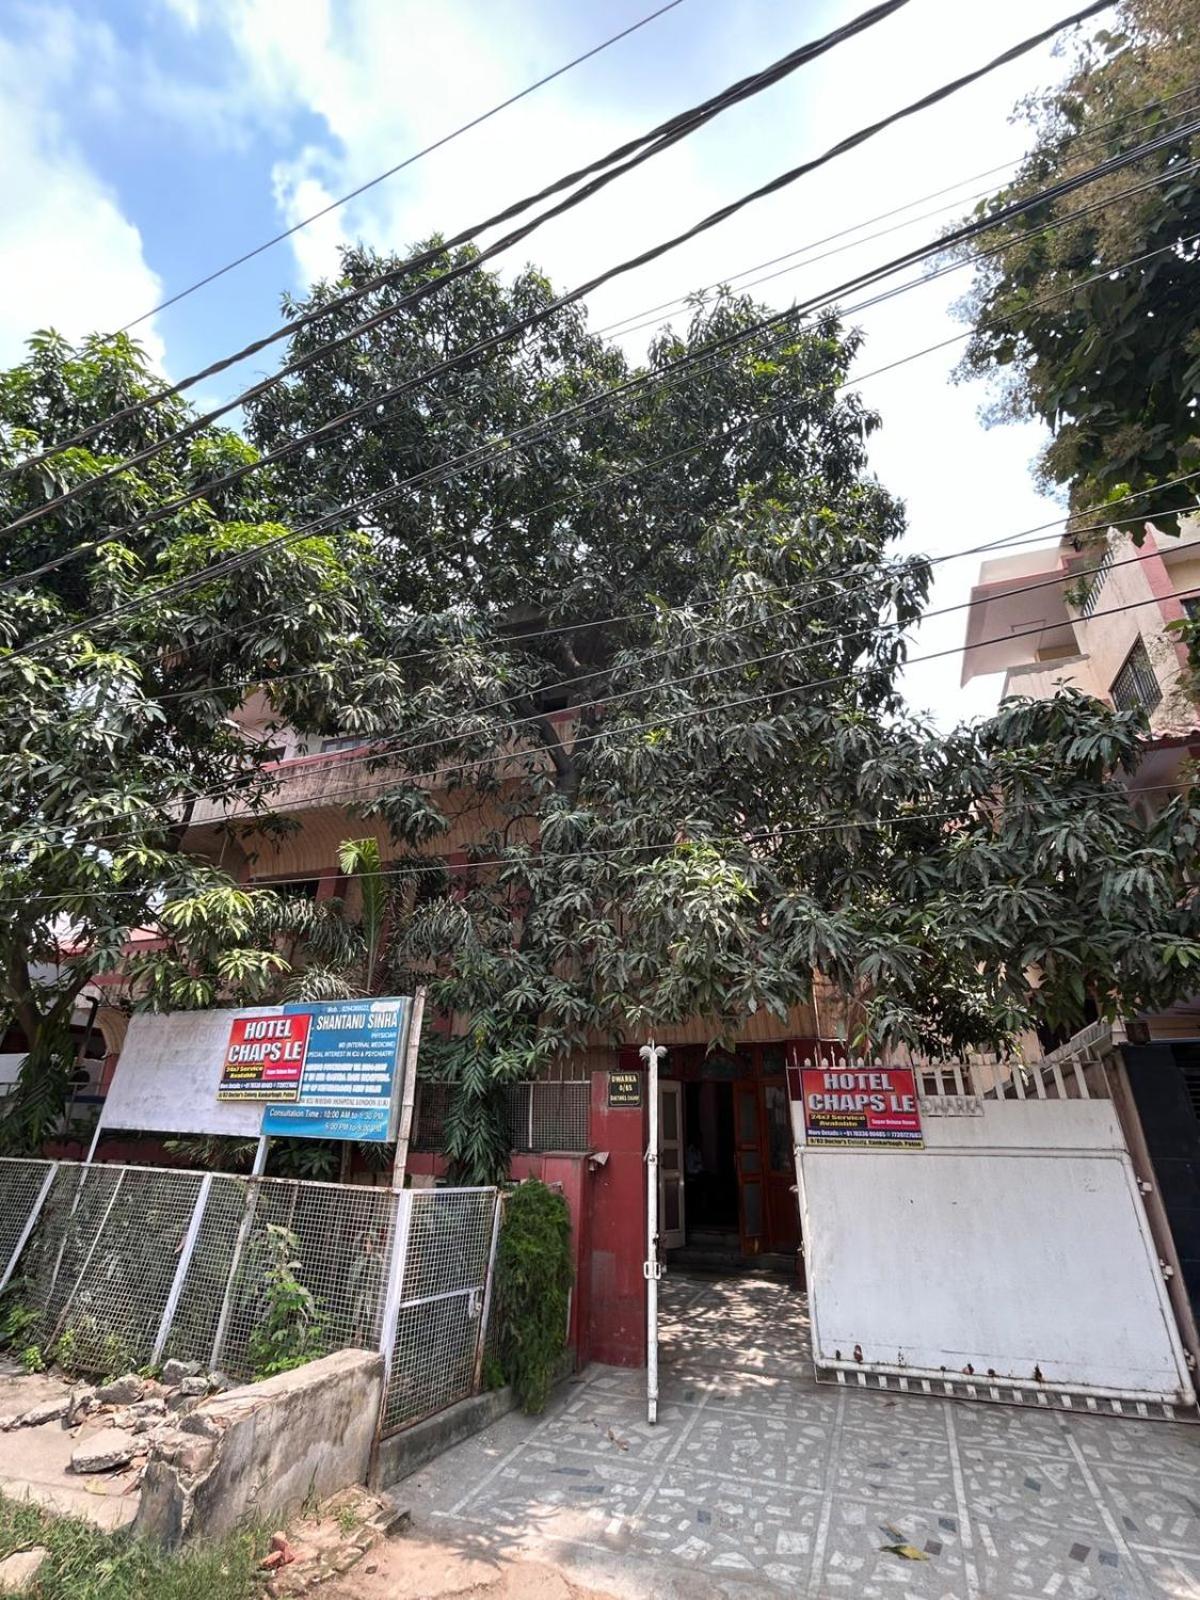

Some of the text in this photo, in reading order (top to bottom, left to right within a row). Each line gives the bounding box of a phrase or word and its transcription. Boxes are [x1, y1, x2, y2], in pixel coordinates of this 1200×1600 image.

[244, 1020, 292, 1040] HOTEL
[316, 1012, 397, 1030] SHANTANU SINHA
[228, 1041, 302, 1062] CHAPS LE
[612, 1075, 637, 1083] DWARKA
[823, 1073, 894, 1090] HOTEL
[808, 1093, 916, 1112] CHAPS LE
[920, 1097, 984, 1115] DWARKA
[270, 1108, 304, 1118] Consultation
